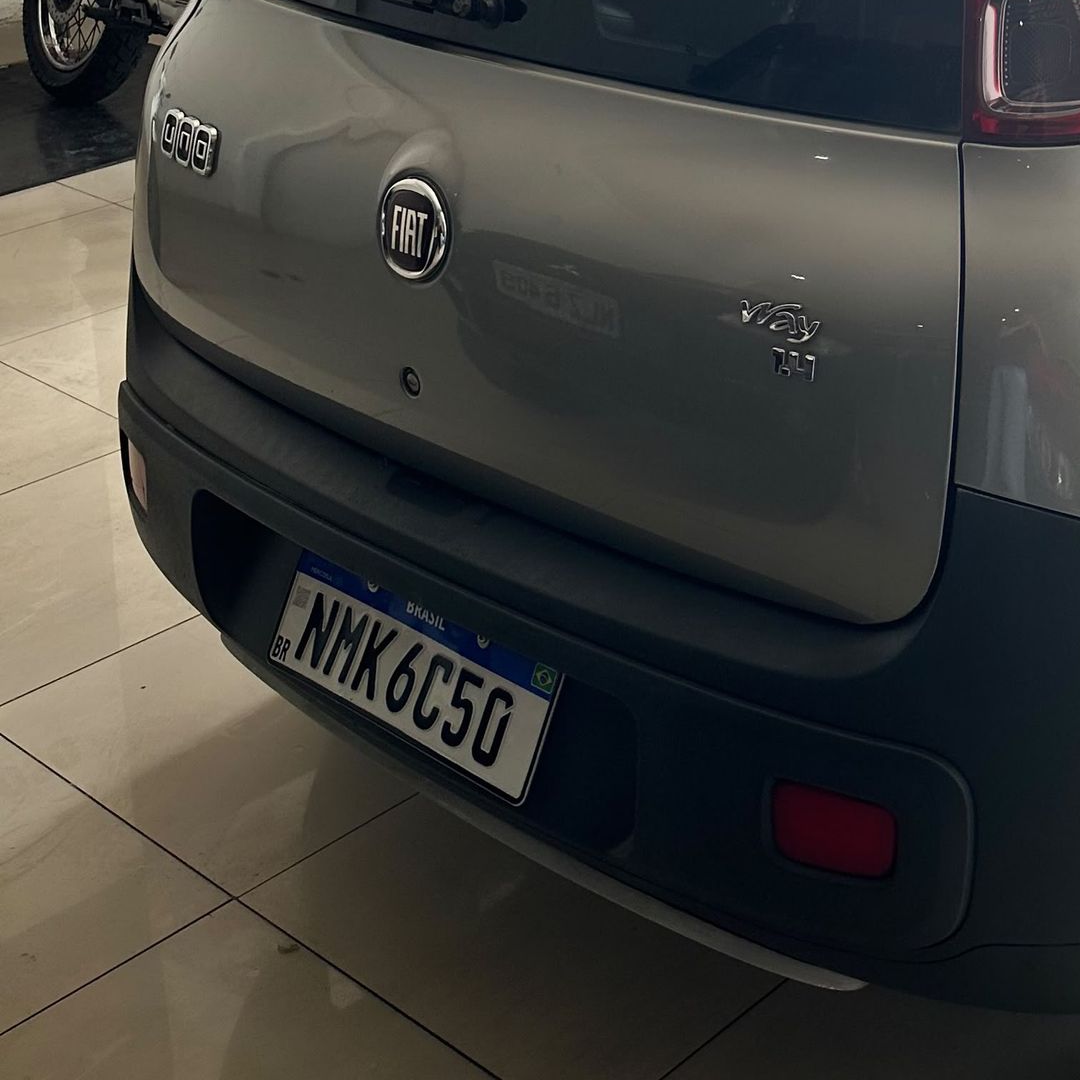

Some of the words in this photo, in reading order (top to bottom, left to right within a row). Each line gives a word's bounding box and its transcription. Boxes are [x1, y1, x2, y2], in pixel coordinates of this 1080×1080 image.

[391, 204, 428, 258] FIAT
[770, 346, 816, 382] 1.4
[405, 599, 446, 632] BRASIL
[271, 635, 291, 662] BR
[294, 591, 514, 767] NMK6C50
